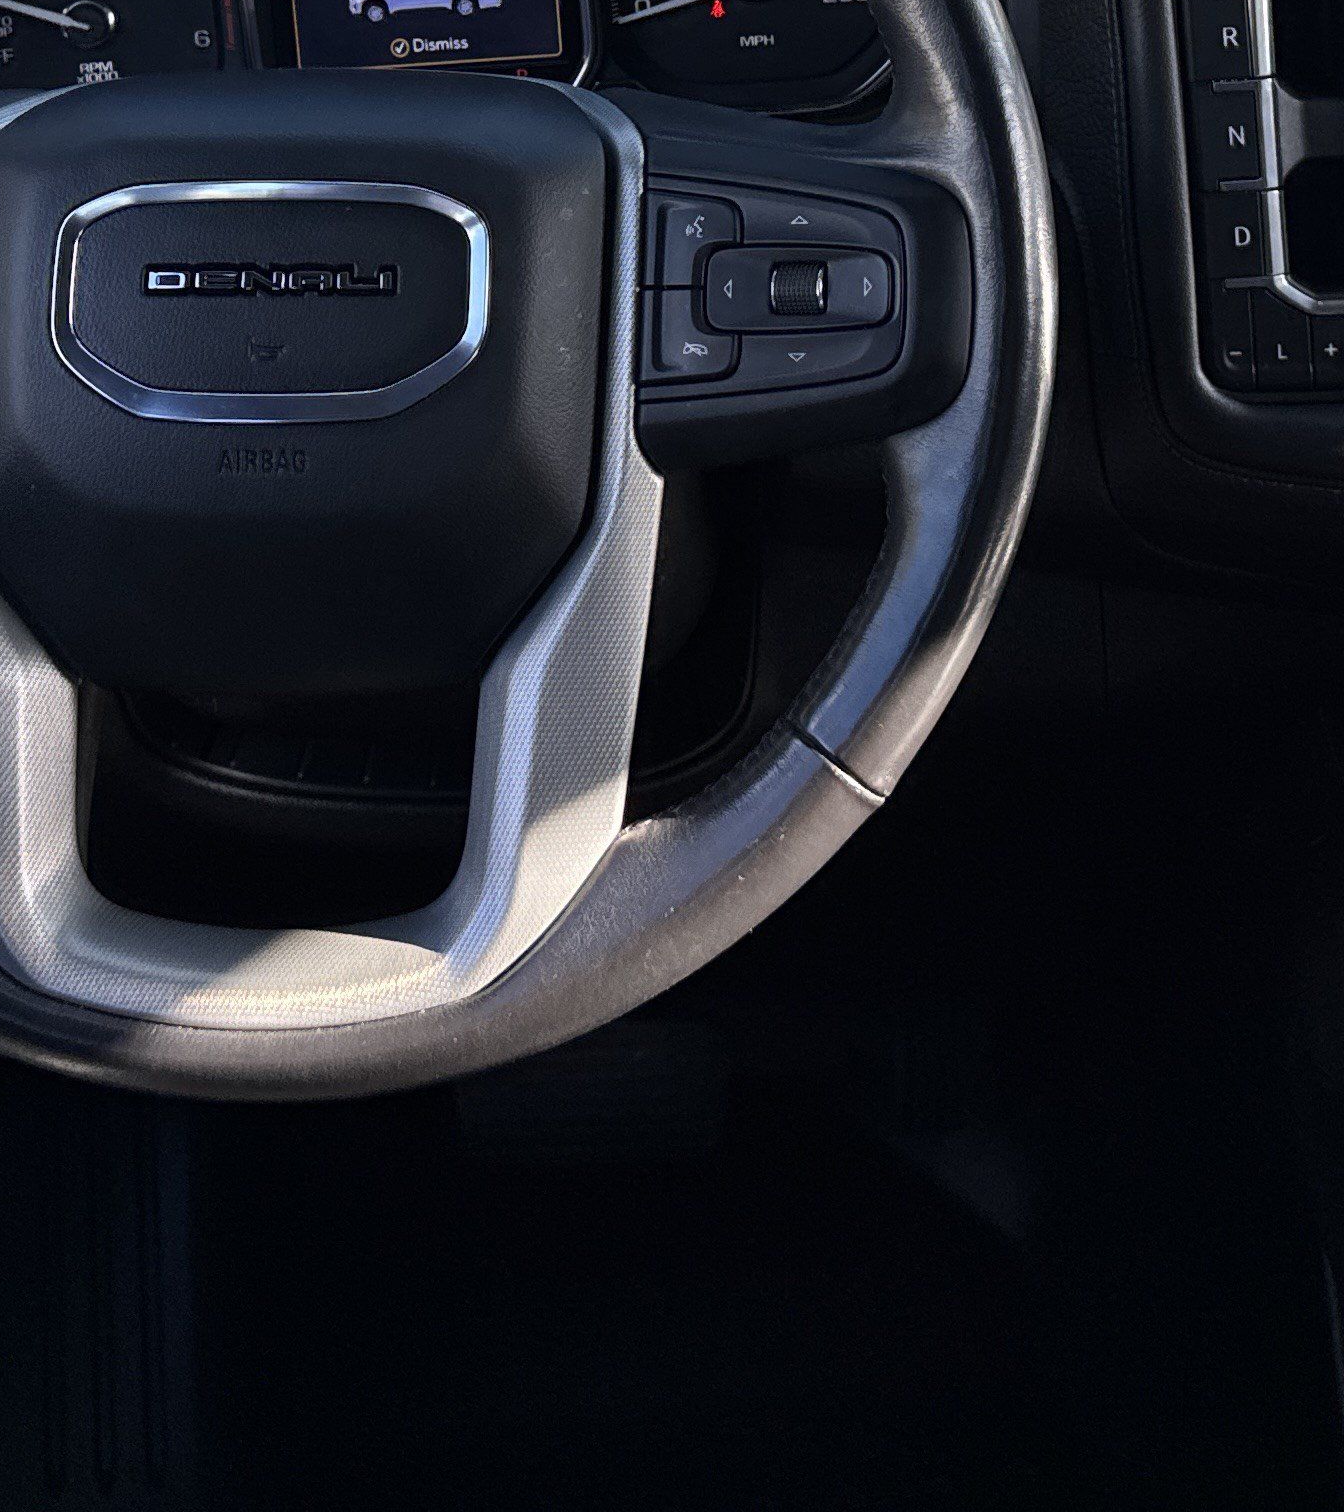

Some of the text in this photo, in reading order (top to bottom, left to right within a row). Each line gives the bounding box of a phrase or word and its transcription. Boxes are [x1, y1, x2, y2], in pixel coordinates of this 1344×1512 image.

[194, 29, 211, 49] 6
[412, 34, 469, 54] Dismiss
[739, 34, 775, 47] MPH
[1222, 26, 1241, 48] R
[78, 60, 114, 75] RPM
[1227, 125, 1248, 147] N
[1234, 226, 1252, 247] D
[146, 267, 397, 294] DENALI
[1276, 343, 1289, 361] L
[217, 448, 308, 476] AIRBAG
